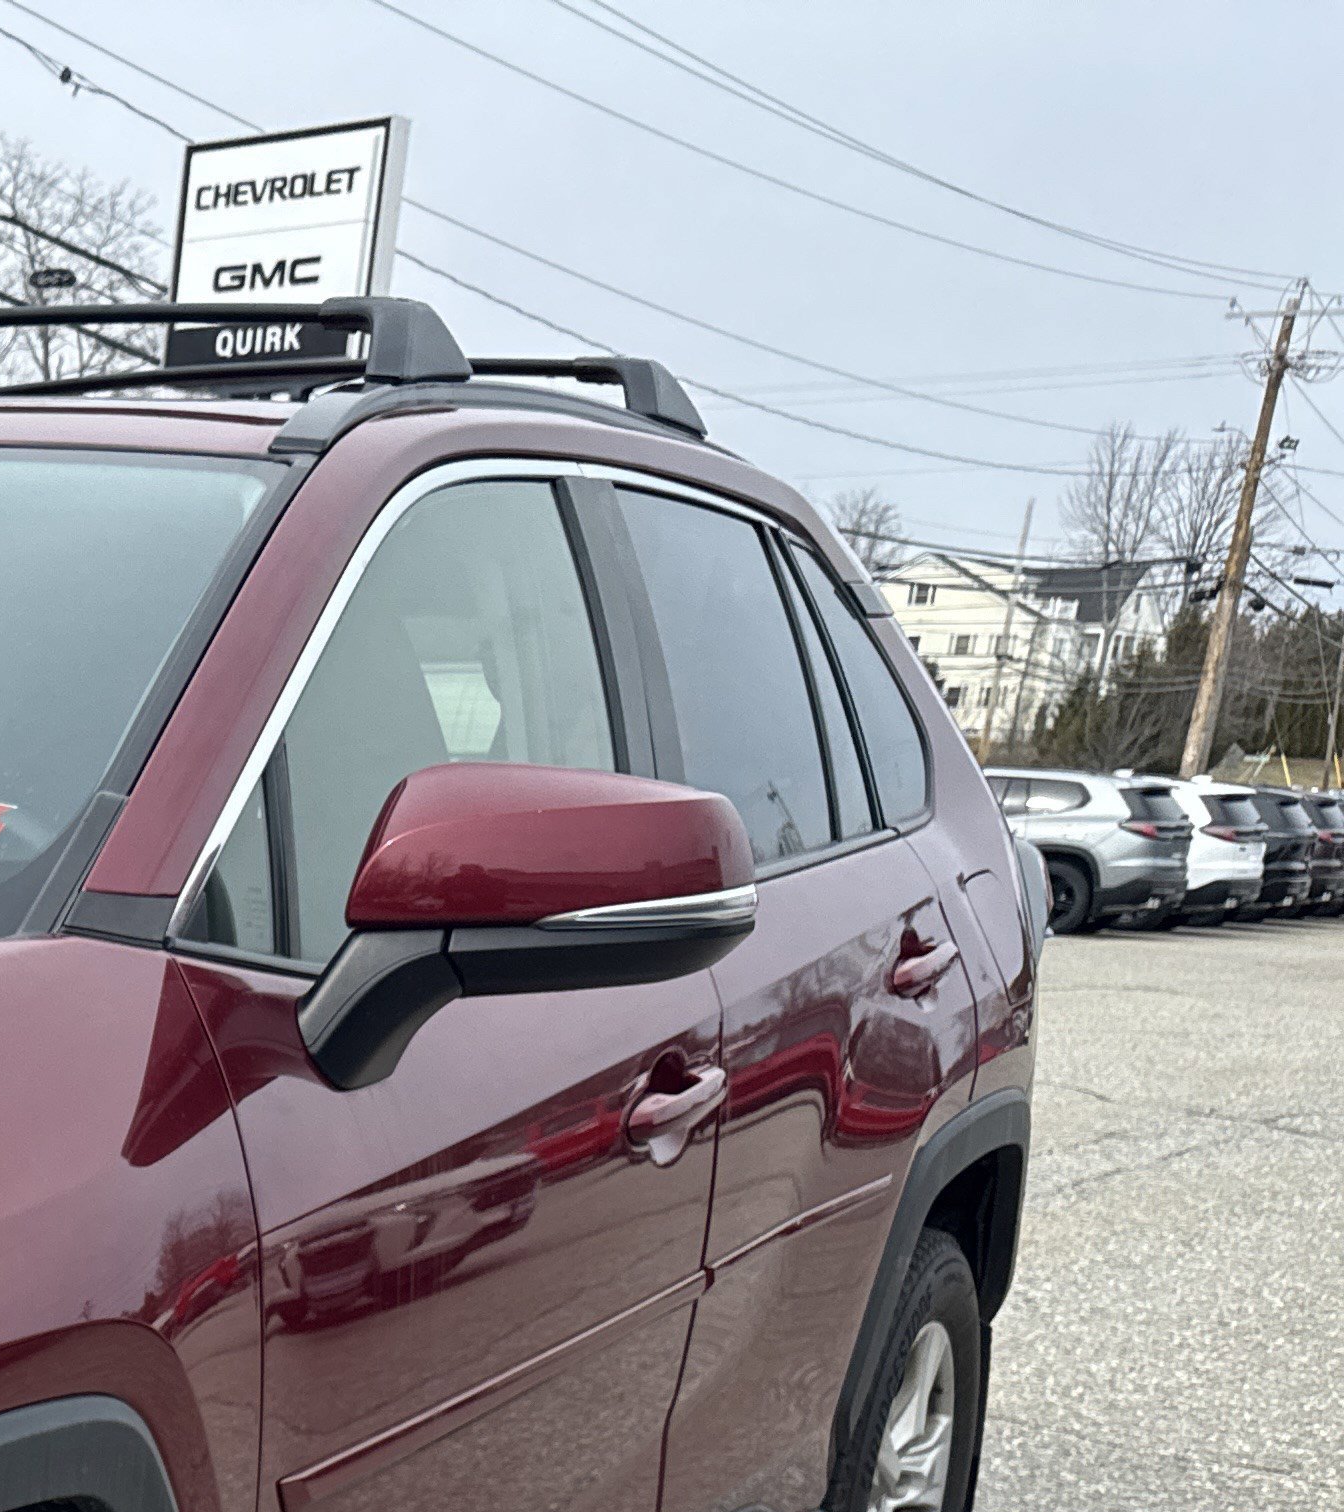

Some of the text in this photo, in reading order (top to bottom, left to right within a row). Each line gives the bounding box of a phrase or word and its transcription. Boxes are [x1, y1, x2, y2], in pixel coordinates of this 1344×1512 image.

[194, 165, 361, 211] CHEVROLET
[213, 255, 321, 292] GMC
[214, 322, 302, 358] QUIRK
